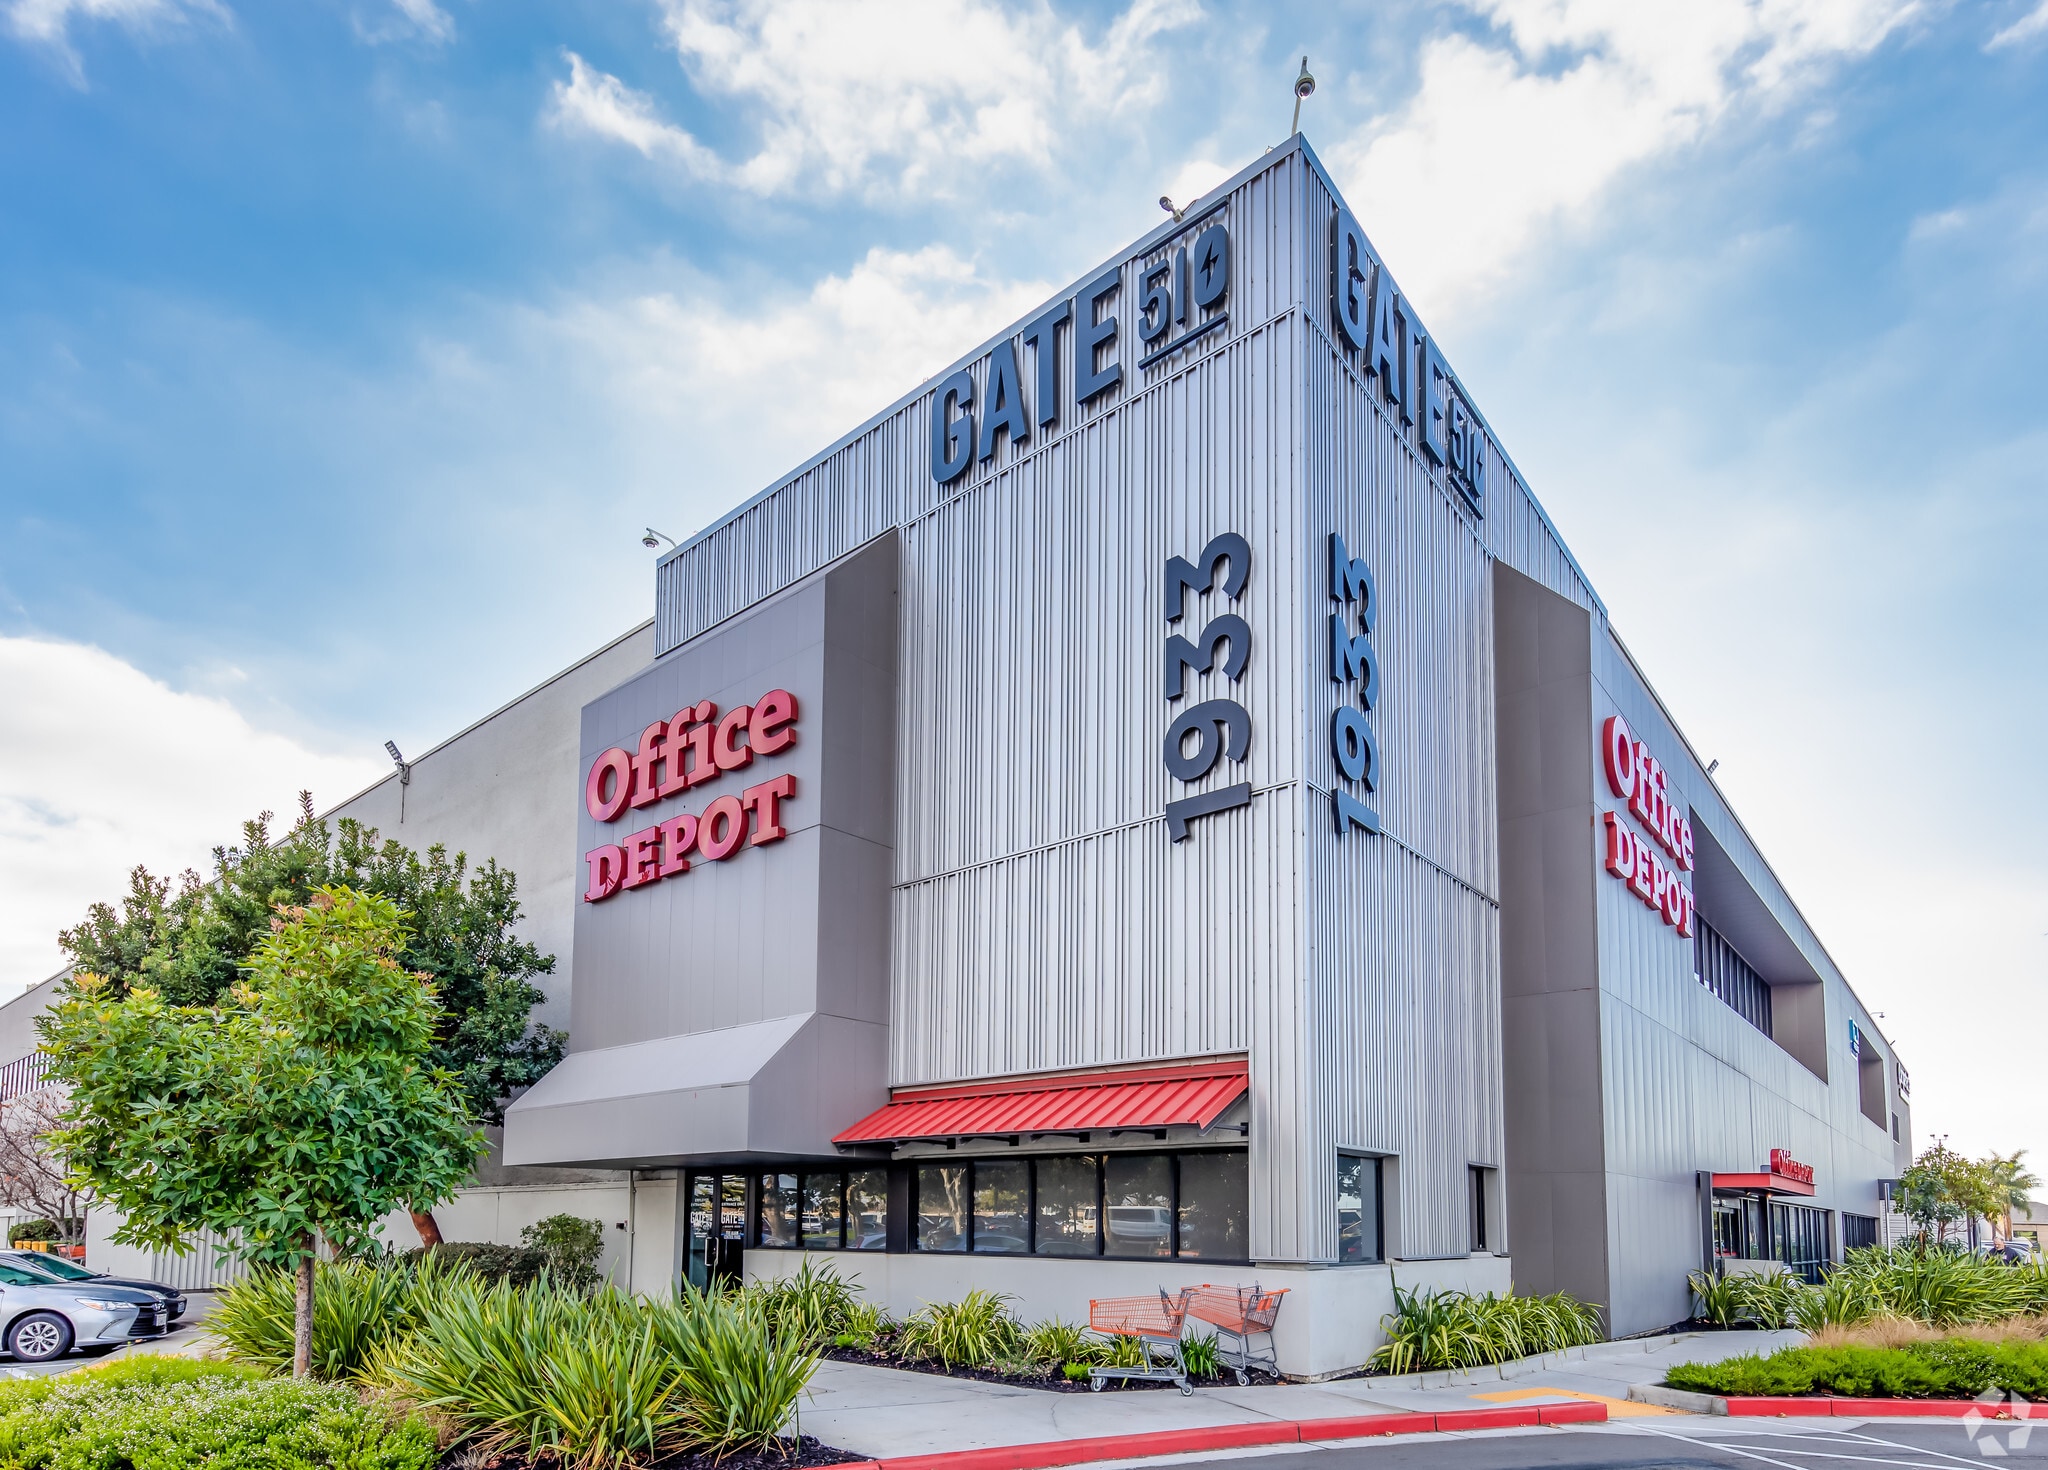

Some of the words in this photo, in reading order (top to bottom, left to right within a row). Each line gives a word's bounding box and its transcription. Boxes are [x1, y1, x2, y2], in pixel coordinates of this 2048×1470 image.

[931, 265, 1122, 485] GATE
[1138, 222, 1230, 343] 510
[1331, 206, 1447, 468] GATE
[1448, 397, 1485, 498] 510
[586, 688, 799, 823] Office
[1163, 532, 1252, 844] 1933
[1328, 531, 1380, 837] 1933
[584, 773, 797, 904] DEPOT
[1602, 715, 1694, 872] Office
[1603, 811, 1694, 939] DEPOT
[721, 1211, 738, 1224] GATE
